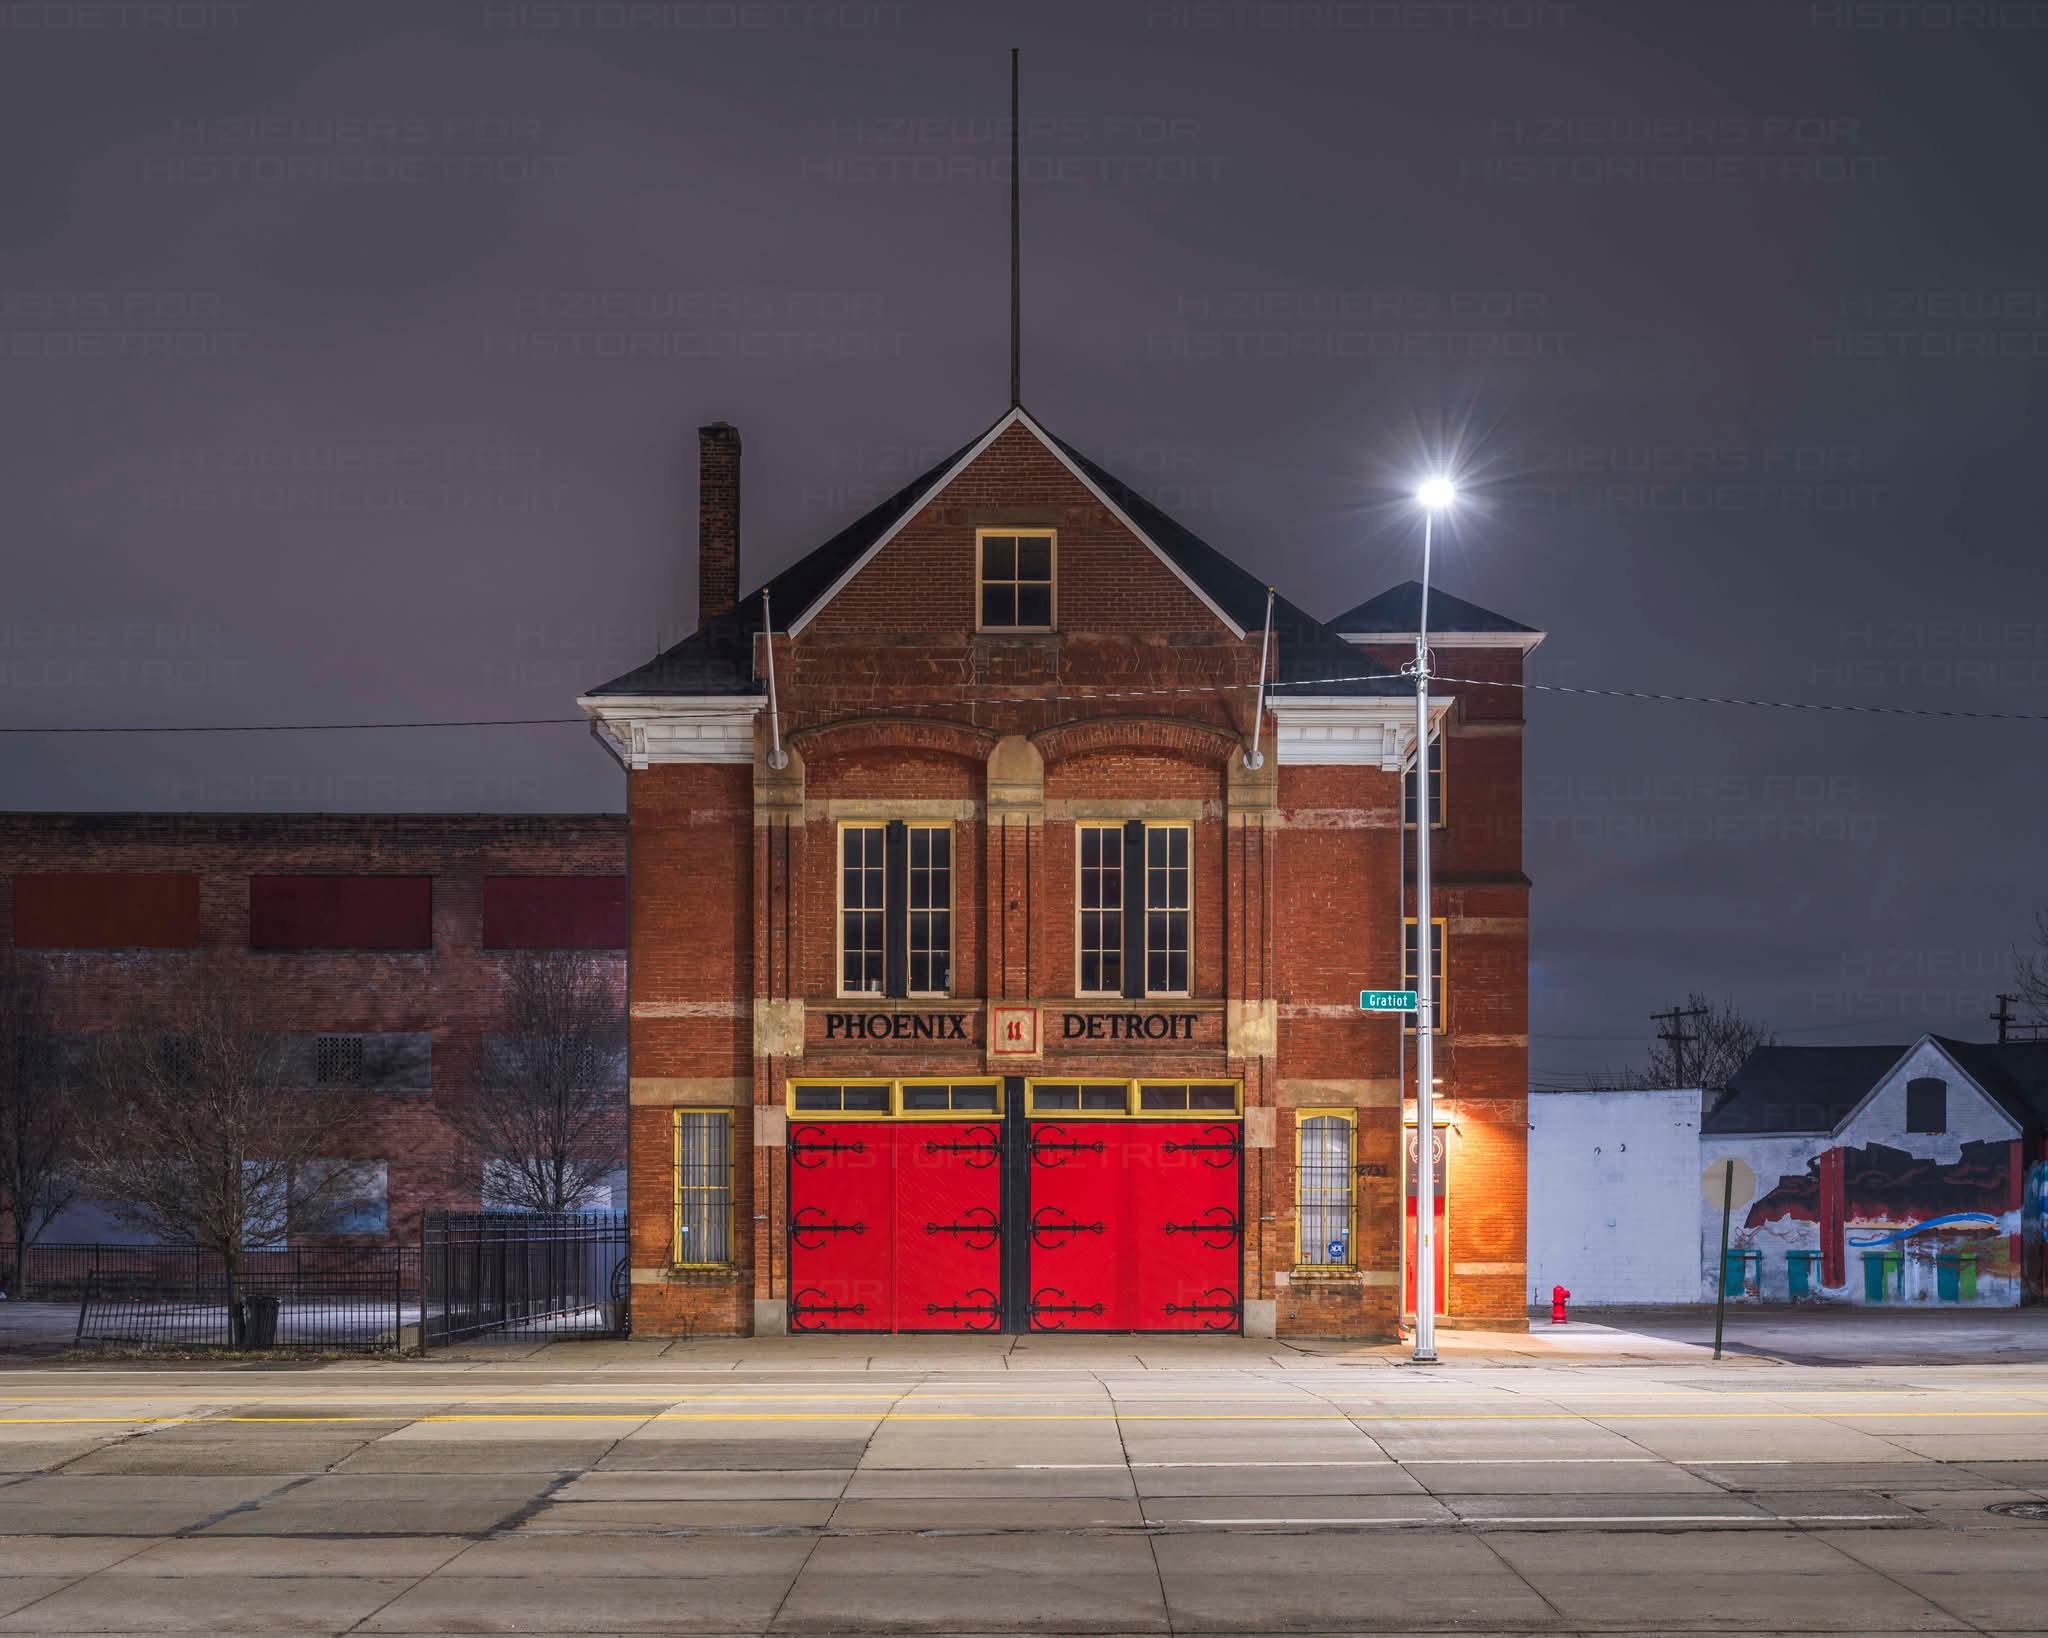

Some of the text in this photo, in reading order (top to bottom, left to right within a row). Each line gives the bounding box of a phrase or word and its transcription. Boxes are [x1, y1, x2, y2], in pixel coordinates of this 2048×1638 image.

[1370, 994, 1408, 1007] Gratiot
[825, 1013, 968, 1039] PHOENIX
[1007, 1021, 1022, 1040] 11
[1062, 1013, 1198, 1039] DETROIT
